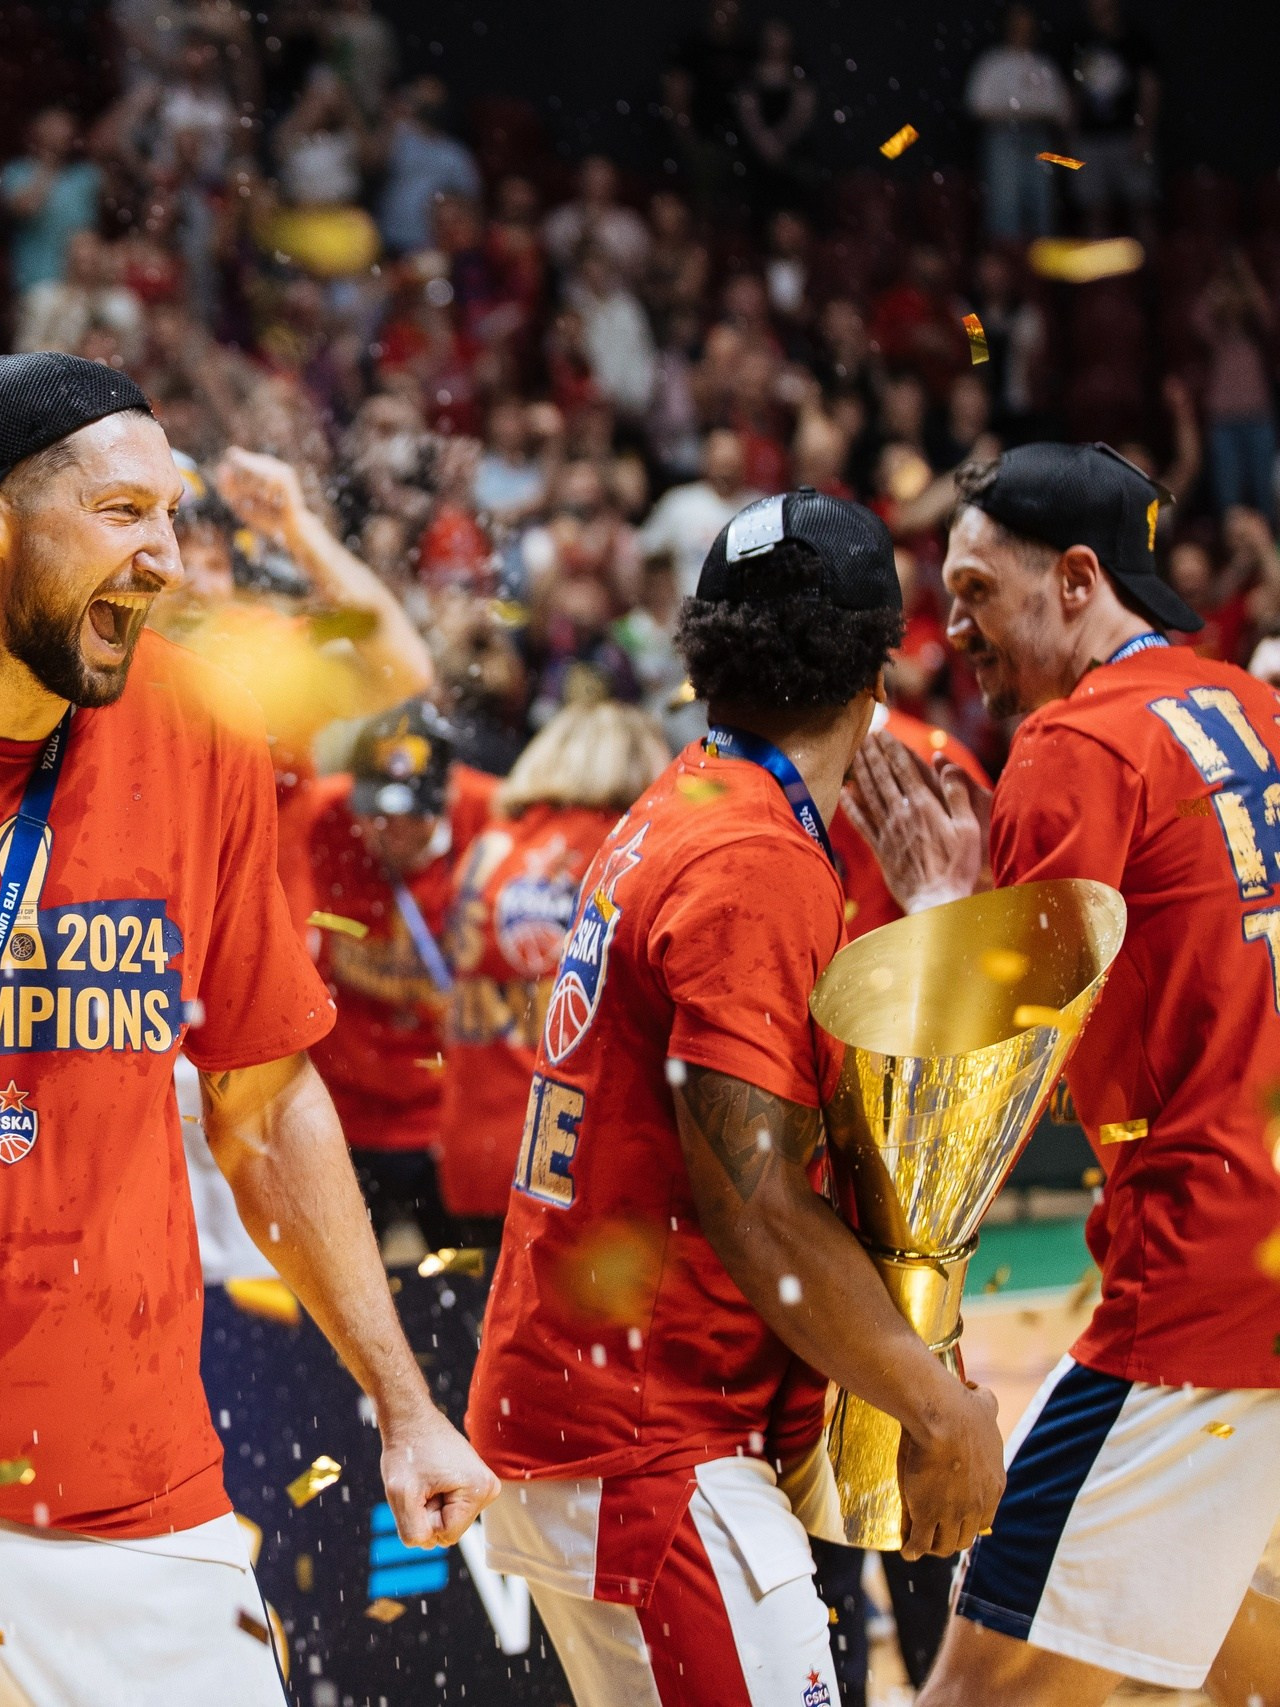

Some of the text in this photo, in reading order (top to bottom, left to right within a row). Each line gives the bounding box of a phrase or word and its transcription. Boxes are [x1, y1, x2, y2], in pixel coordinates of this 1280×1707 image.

[3, 882, 21, 910] VTB
[56, 913, 169, 974] 2024
[567, 918, 602, 966] CSKA
